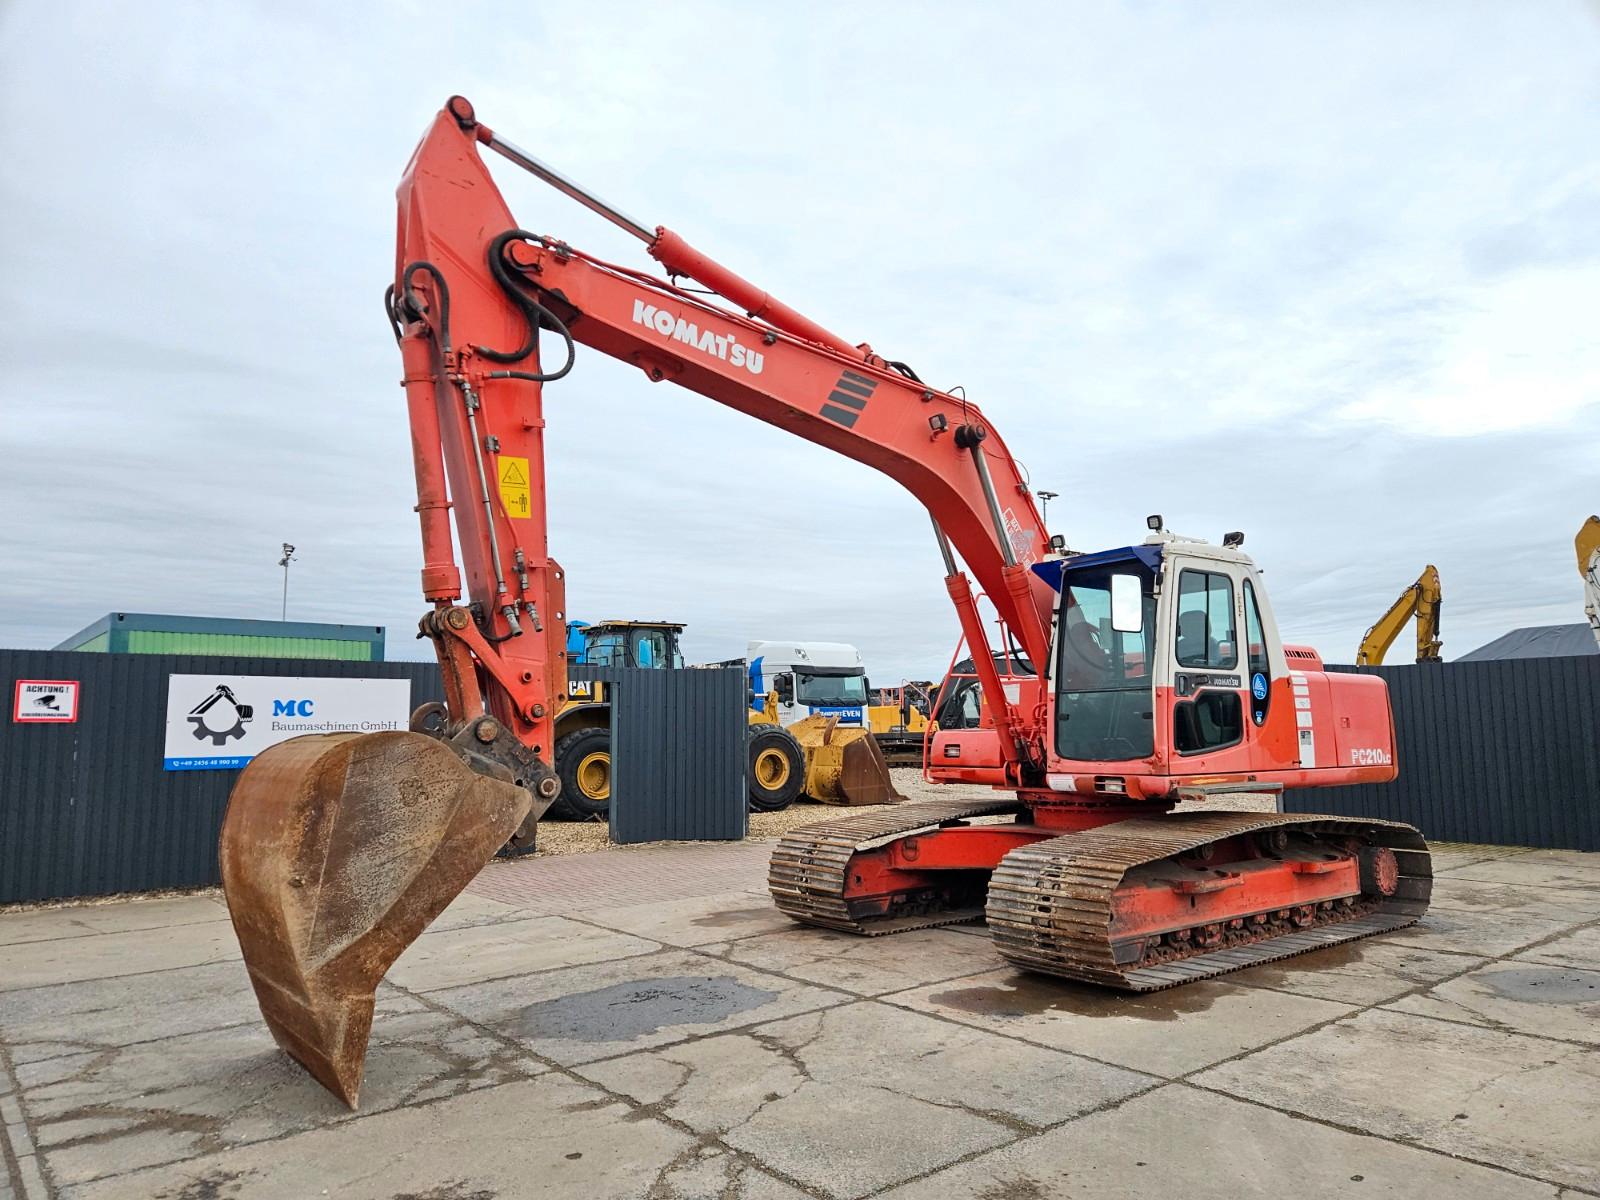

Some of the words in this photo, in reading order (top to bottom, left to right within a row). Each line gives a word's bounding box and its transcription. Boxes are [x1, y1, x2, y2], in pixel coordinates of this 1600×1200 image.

[632, 299, 764, 374] KOMATSU
[26, 685, 64, 693] ACHTUNG
[569, 680, 591, 696] CAT
[272, 699, 314, 717] MC
[271, 721, 359, 731] Baumaschinen
[360, 721, 398, 731] GmbH
